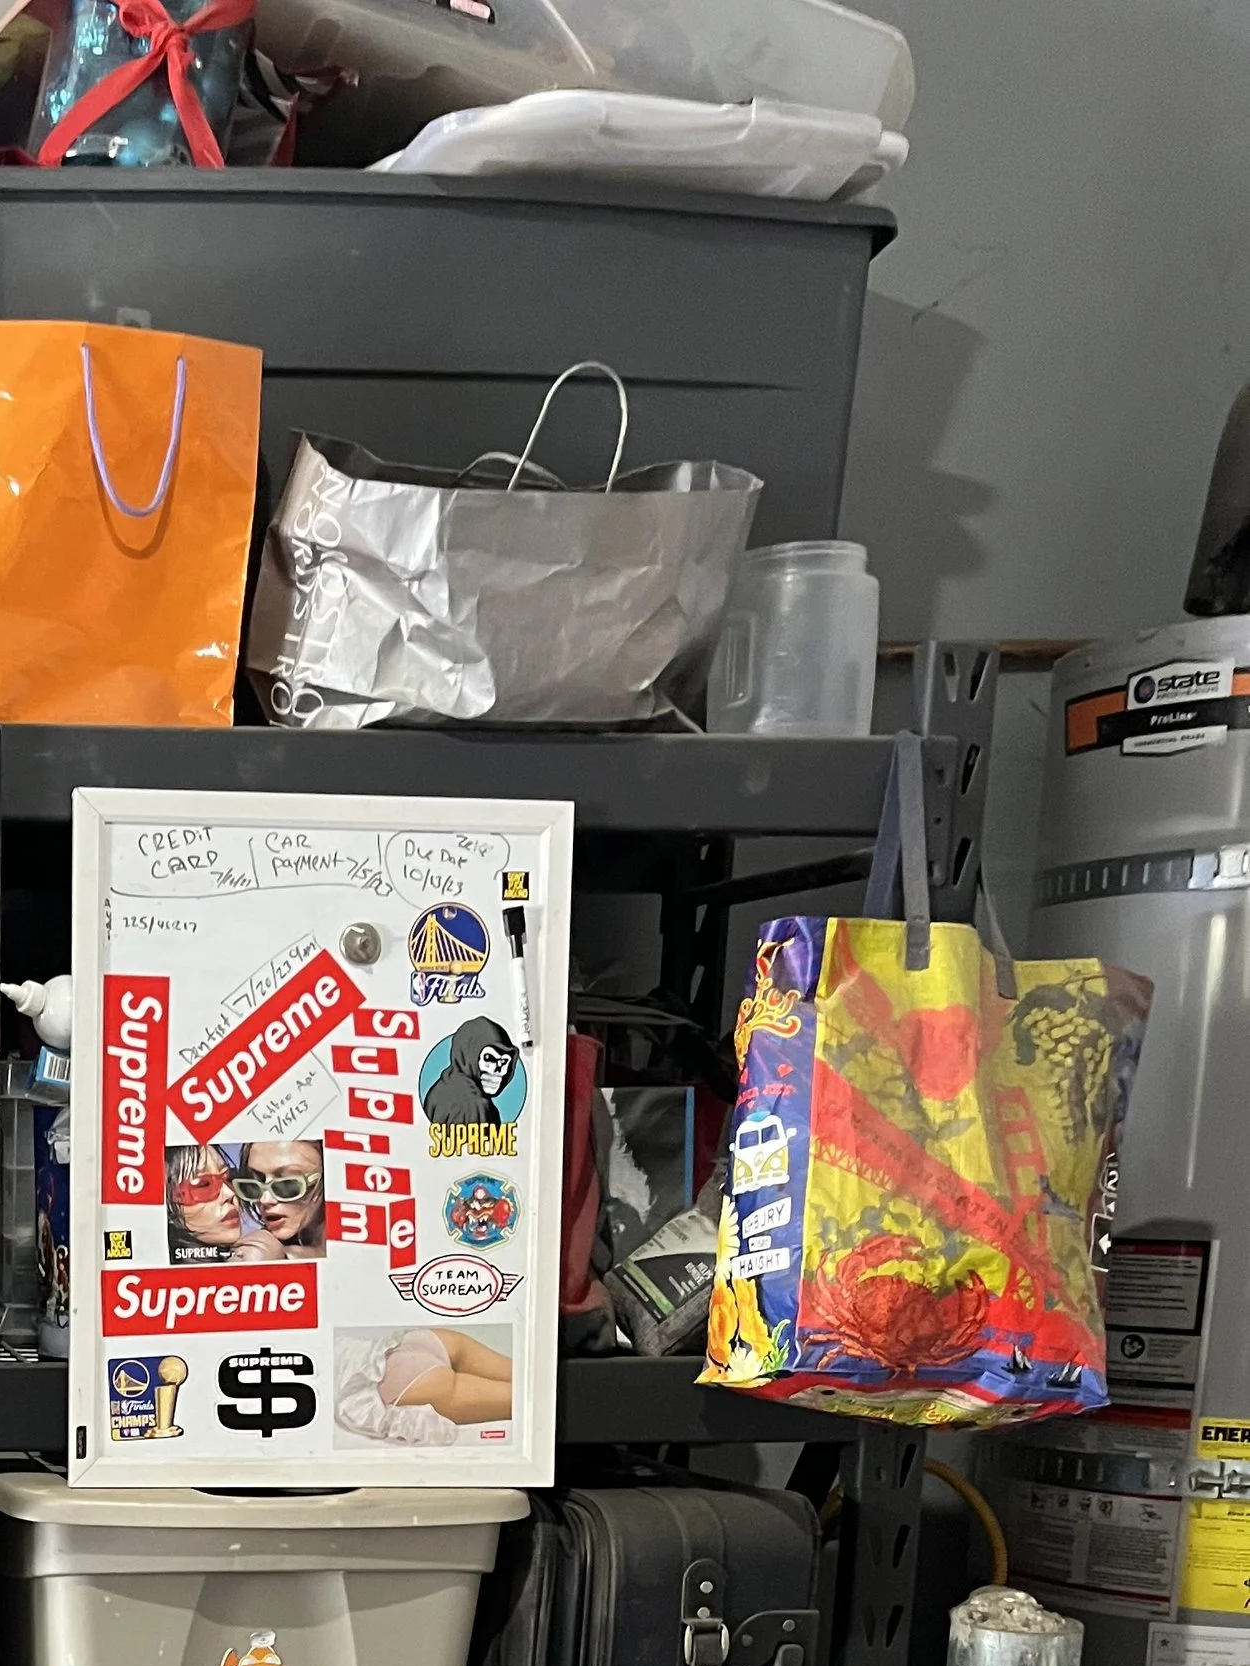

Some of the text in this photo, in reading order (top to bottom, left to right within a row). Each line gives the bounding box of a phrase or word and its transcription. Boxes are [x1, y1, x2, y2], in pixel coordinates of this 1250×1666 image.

[1157, 670, 1221, 693] state
[265, 832, 312, 854] CAR
[181, 974, 341, 1122] Supreme
[106, 990, 164, 1195] Supreme
[428, 1121, 519, 1158] SUPREME
[174, 1247, 218, 1259] SUPREME
[435, 1270, 479, 1280] TEAM
[113, 1274, 306, 1329] Supreme
[422, 1284, 495, 1297] SUPREAM
[228, 1356, 304, 1368] SUPREME
[111, 1414, 156, 1428] CHAMPS
